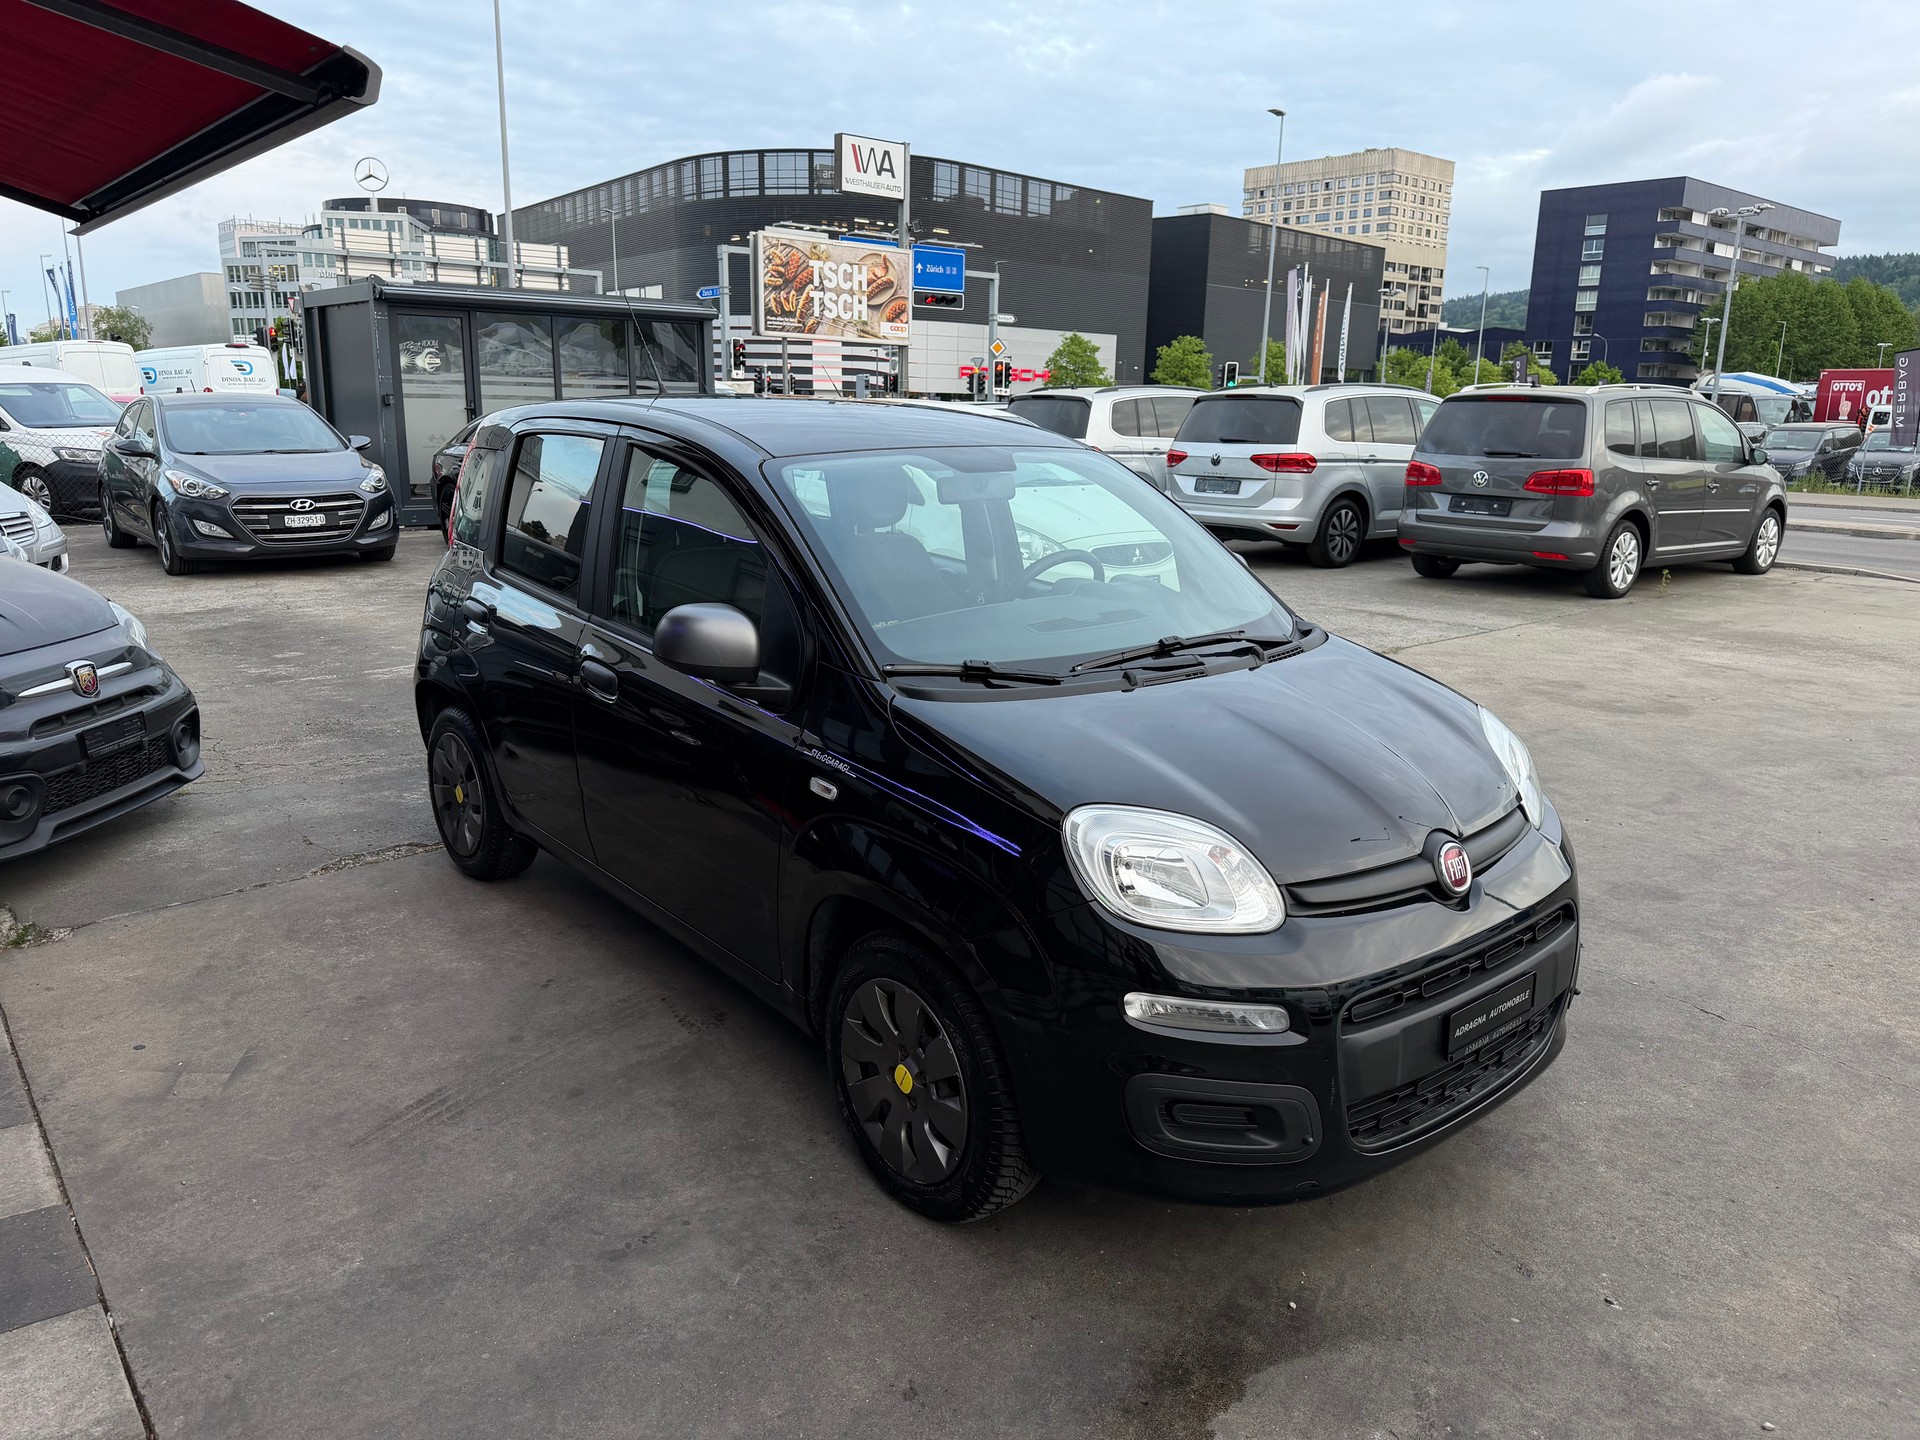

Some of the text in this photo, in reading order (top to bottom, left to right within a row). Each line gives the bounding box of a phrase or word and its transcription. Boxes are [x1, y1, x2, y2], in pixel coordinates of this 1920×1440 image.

[808, 259, 868, 292] TSCH
[926, 264, 944, 274] Zürich
[809, 290, 868, 321] TSCH
[890, 325, 907, 334] coop
[1832, 382, 1863, 392] OTTO'S
[1447, 855, 1467, 881] FIAT
[1454, 989, 1531, 1039] ADRAGNA AUTOMOBILE
